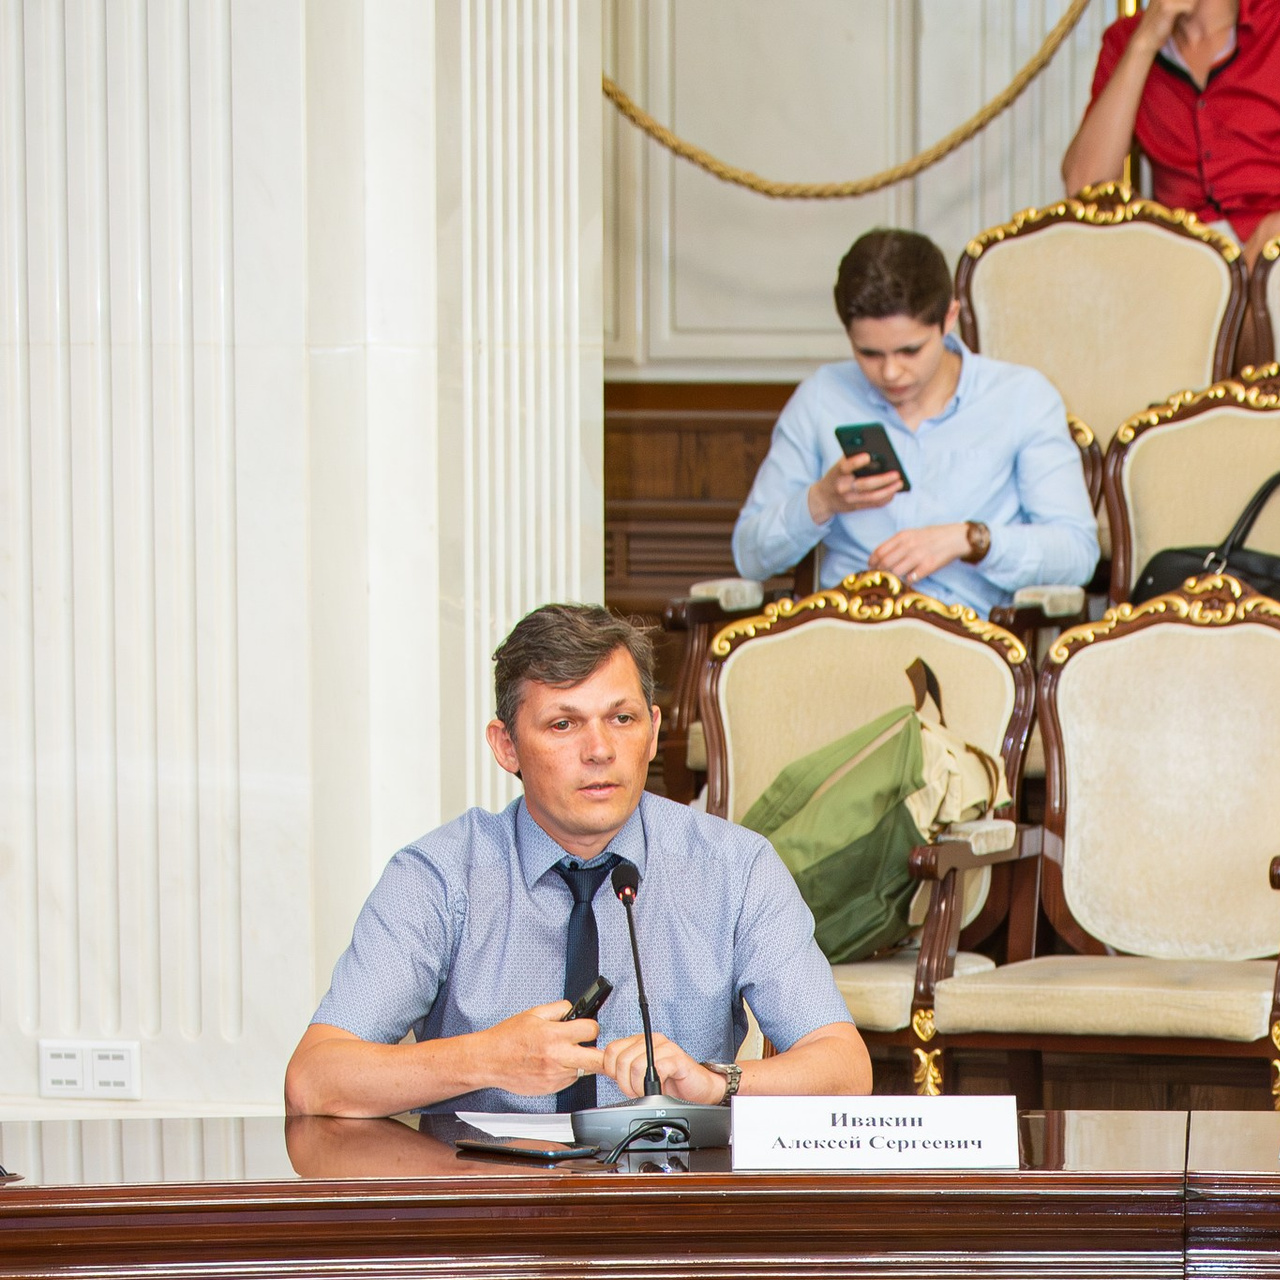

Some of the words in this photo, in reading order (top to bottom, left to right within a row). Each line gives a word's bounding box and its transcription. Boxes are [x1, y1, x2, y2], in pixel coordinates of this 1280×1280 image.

[830, 1112, 924, 1128] Ивакин
[771, 1135, 862, 1150] Алексей
[868, 1135, 983, 1153] Сергеевич
